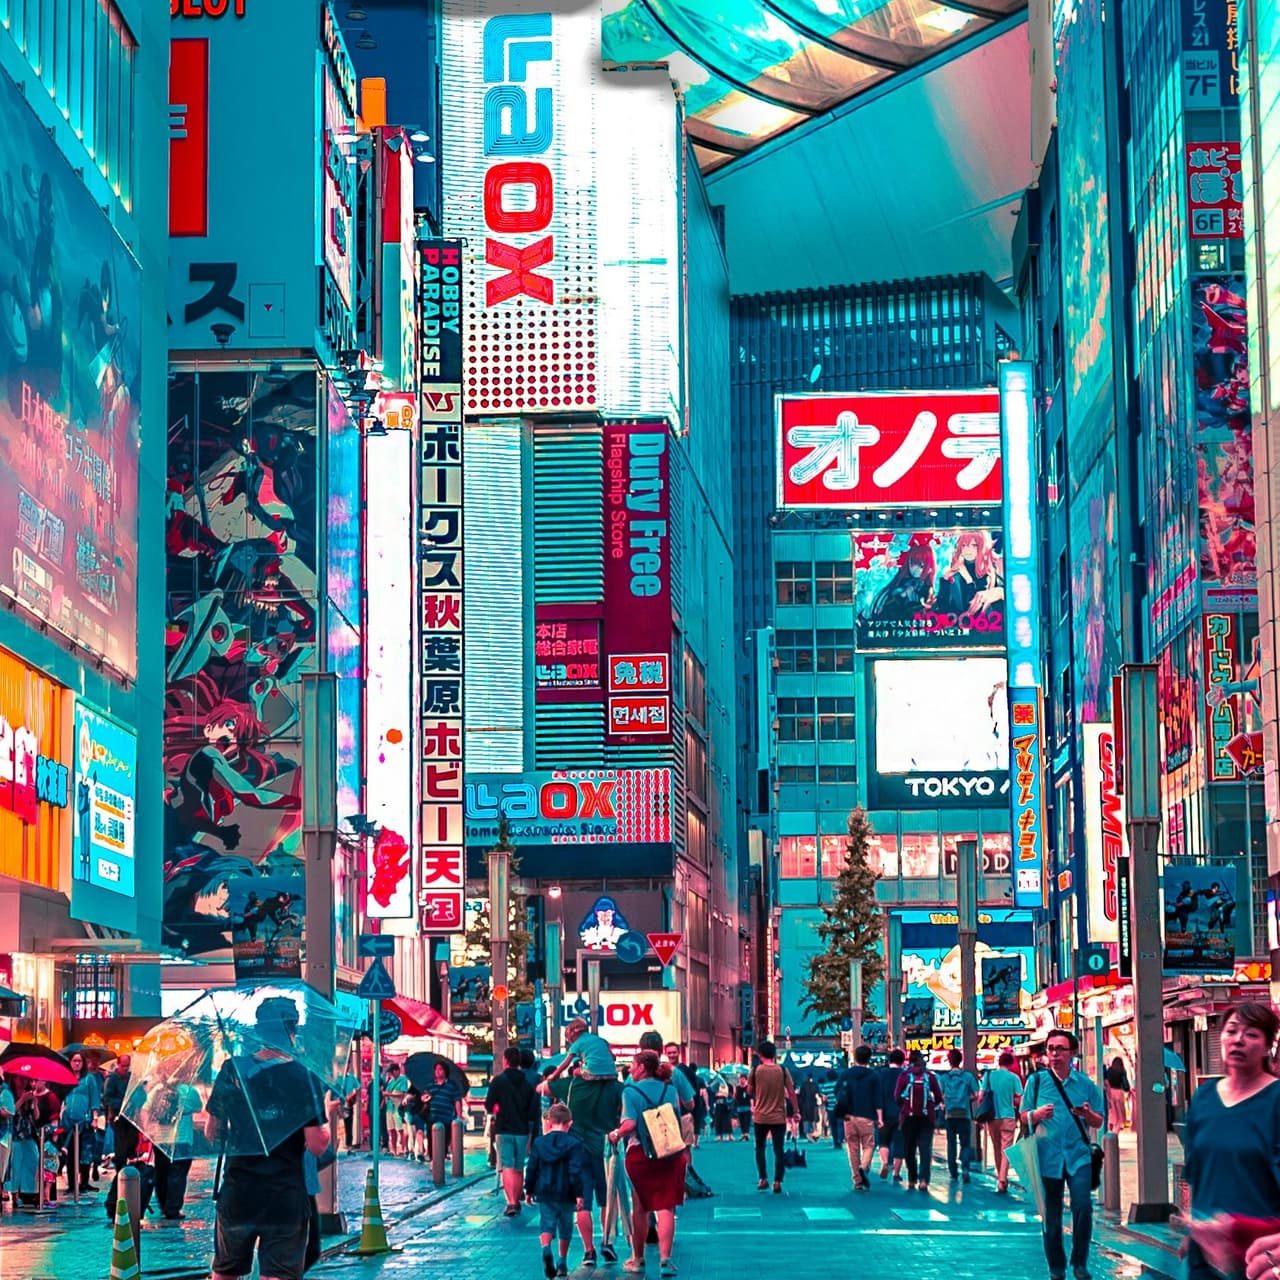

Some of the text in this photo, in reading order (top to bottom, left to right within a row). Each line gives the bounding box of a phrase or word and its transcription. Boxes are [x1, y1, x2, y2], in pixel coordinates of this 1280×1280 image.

[1186, 73, 1218, 97] 7F
[1195, 211, 1221, 233] 6F
[422, 248, 440, 377] PARADISE
[439, 248, 460, 334] HOBBY
[606, 433, 625, 559] Flagship Store
[627, 432, 667, 597] Duty Free
[613, 707, 665, 725] 면세점
[905, 777, 995, 798] TOKYO
